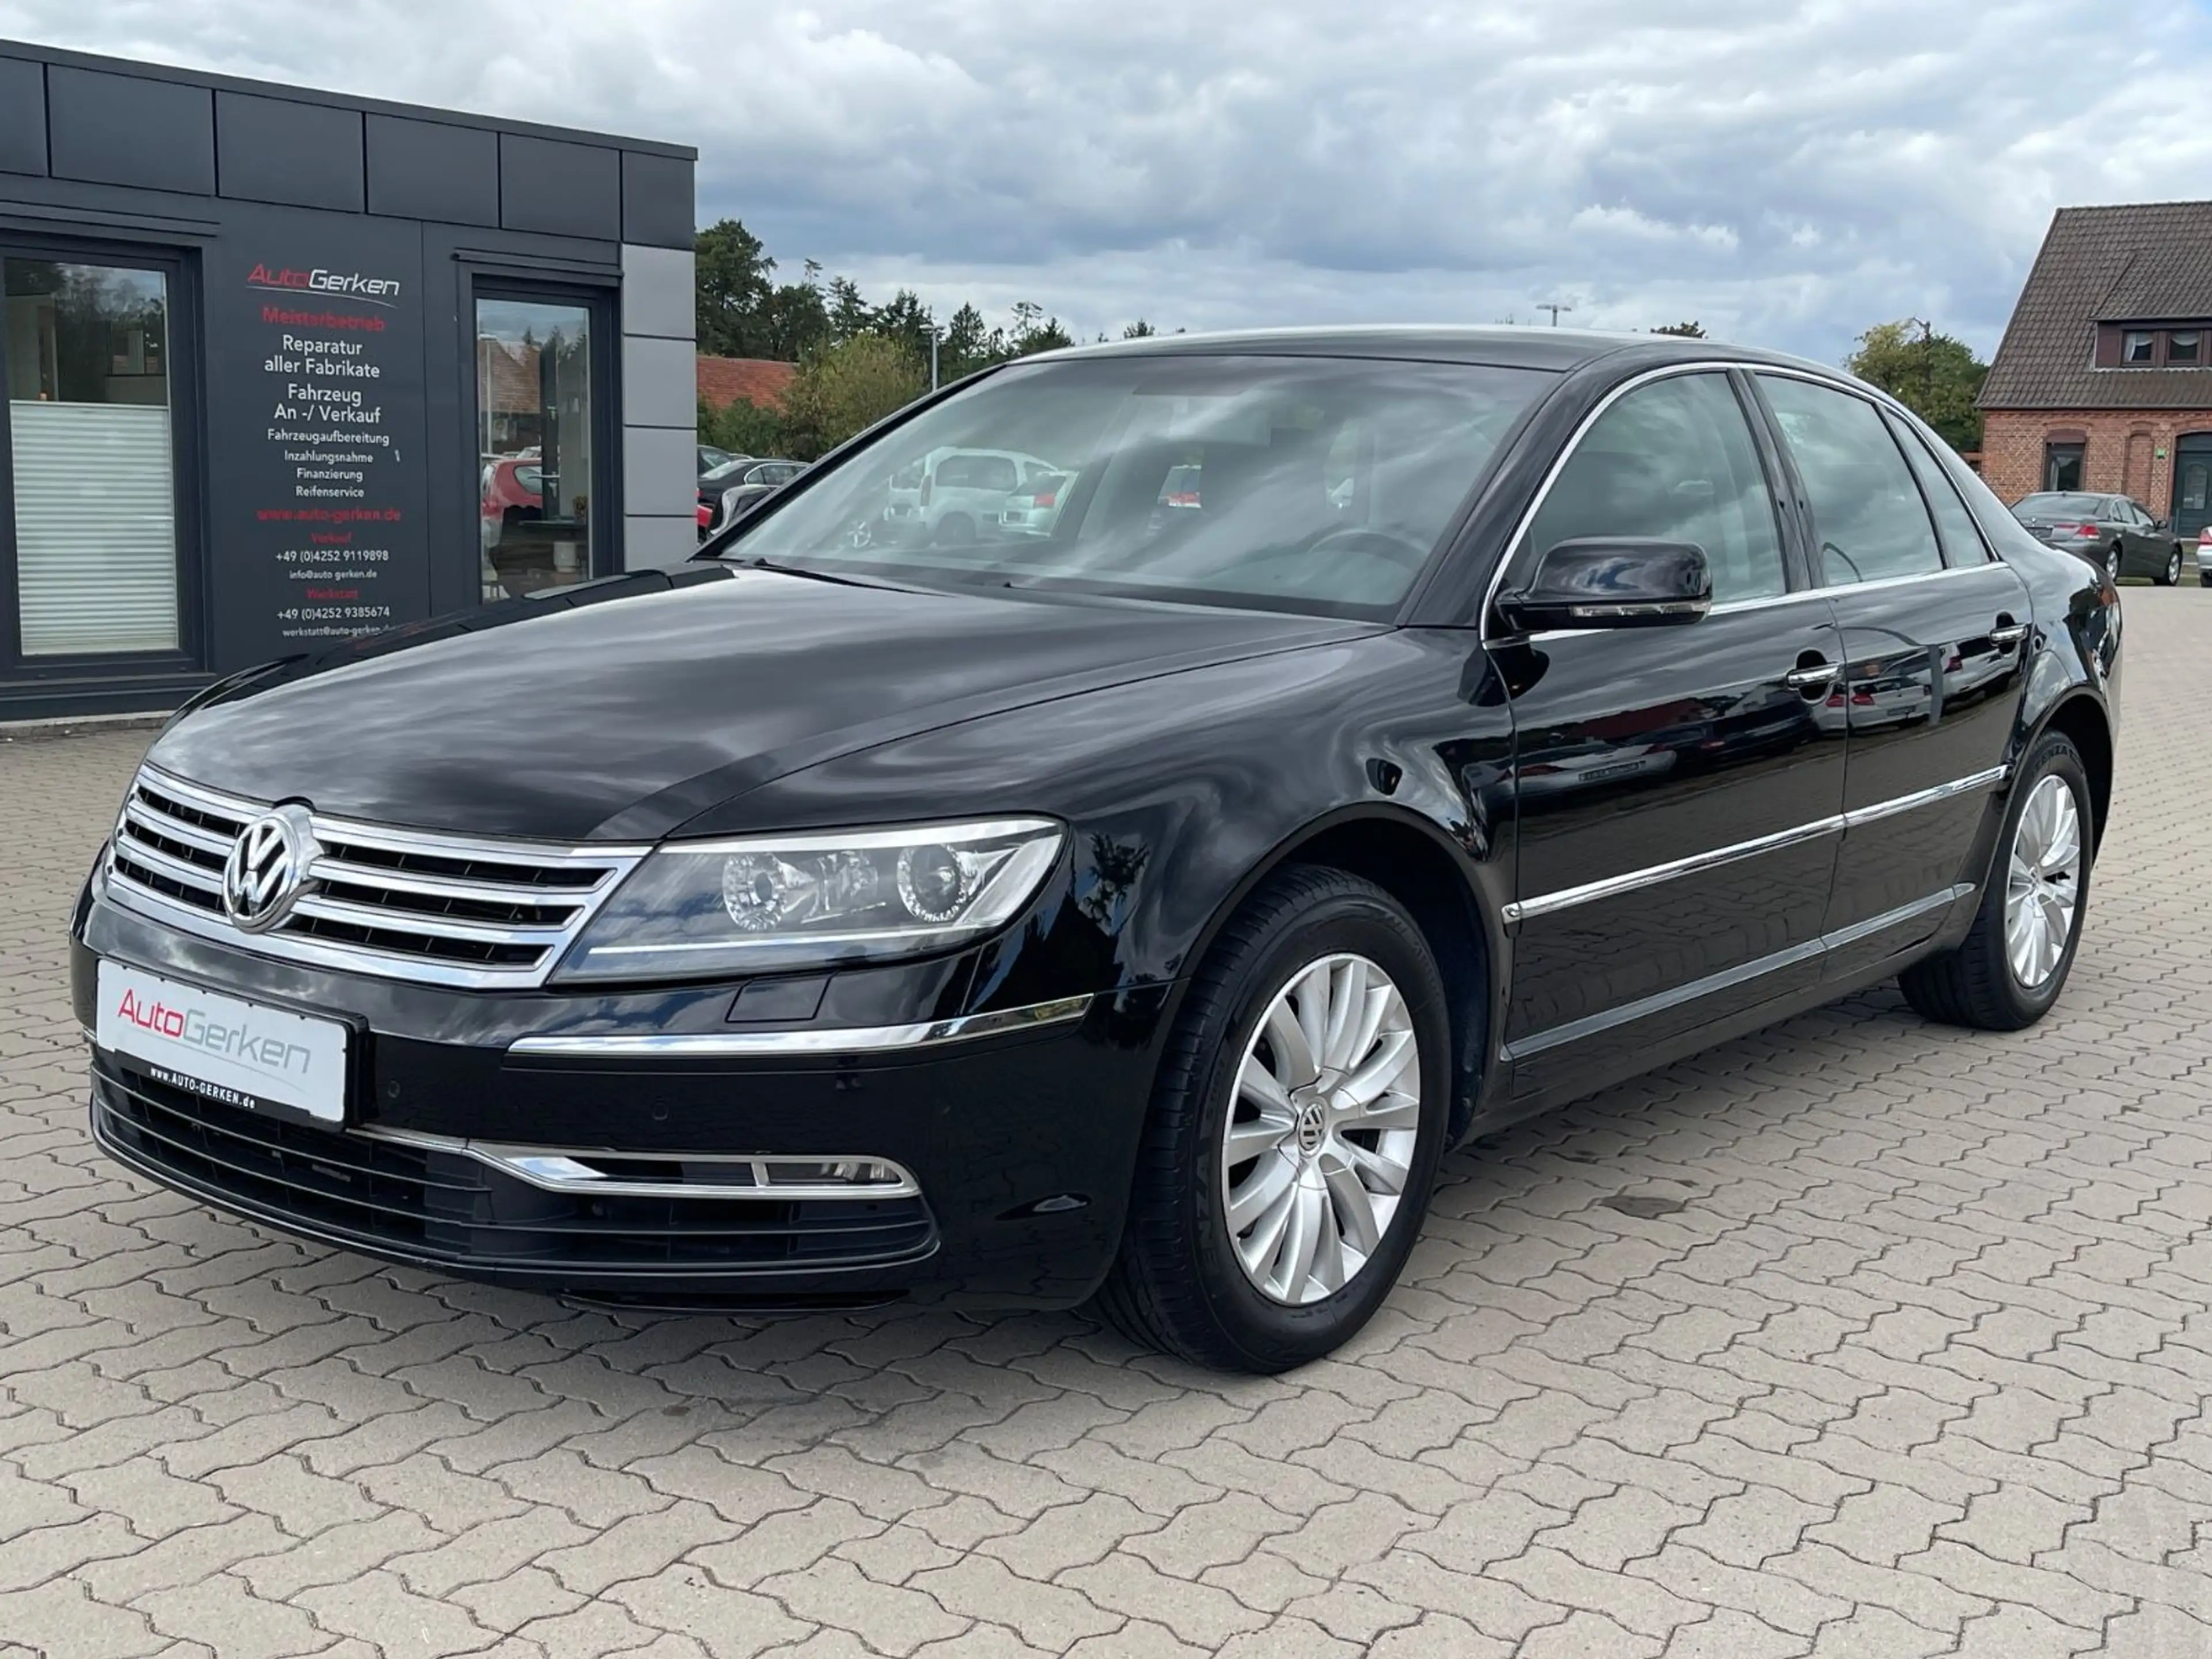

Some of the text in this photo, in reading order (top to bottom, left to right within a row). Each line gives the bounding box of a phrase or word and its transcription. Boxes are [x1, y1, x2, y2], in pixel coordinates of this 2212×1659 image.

[248, 263, 400, 296] AutoGerken
[282, 335, 363, 355] Reparatur
[264, 355, 380, 378] aller Fabrikate
[288, 384, 362, 407] Fahrzeug
[274, 404, 297, 419] An
[319, 406, 381, 423] Verkauf
[267, 429, 390, 446] Fahrzeugaufbereitung
[284, 450, 373, 464] Inzahlungsnahme
[297, 468, 363, 482] Finanzierung
[296, 486, 365, 497] Reifenservice
[275, 550, 389, 563] +49 (0)4252 9119898
[277, 607, 390, 621] +49 (0)4252 9385674
[118, 988, 311, 1074] AutoGerken
[150, 1067, 255, 1109] www.AUTO-GERKEN.de
